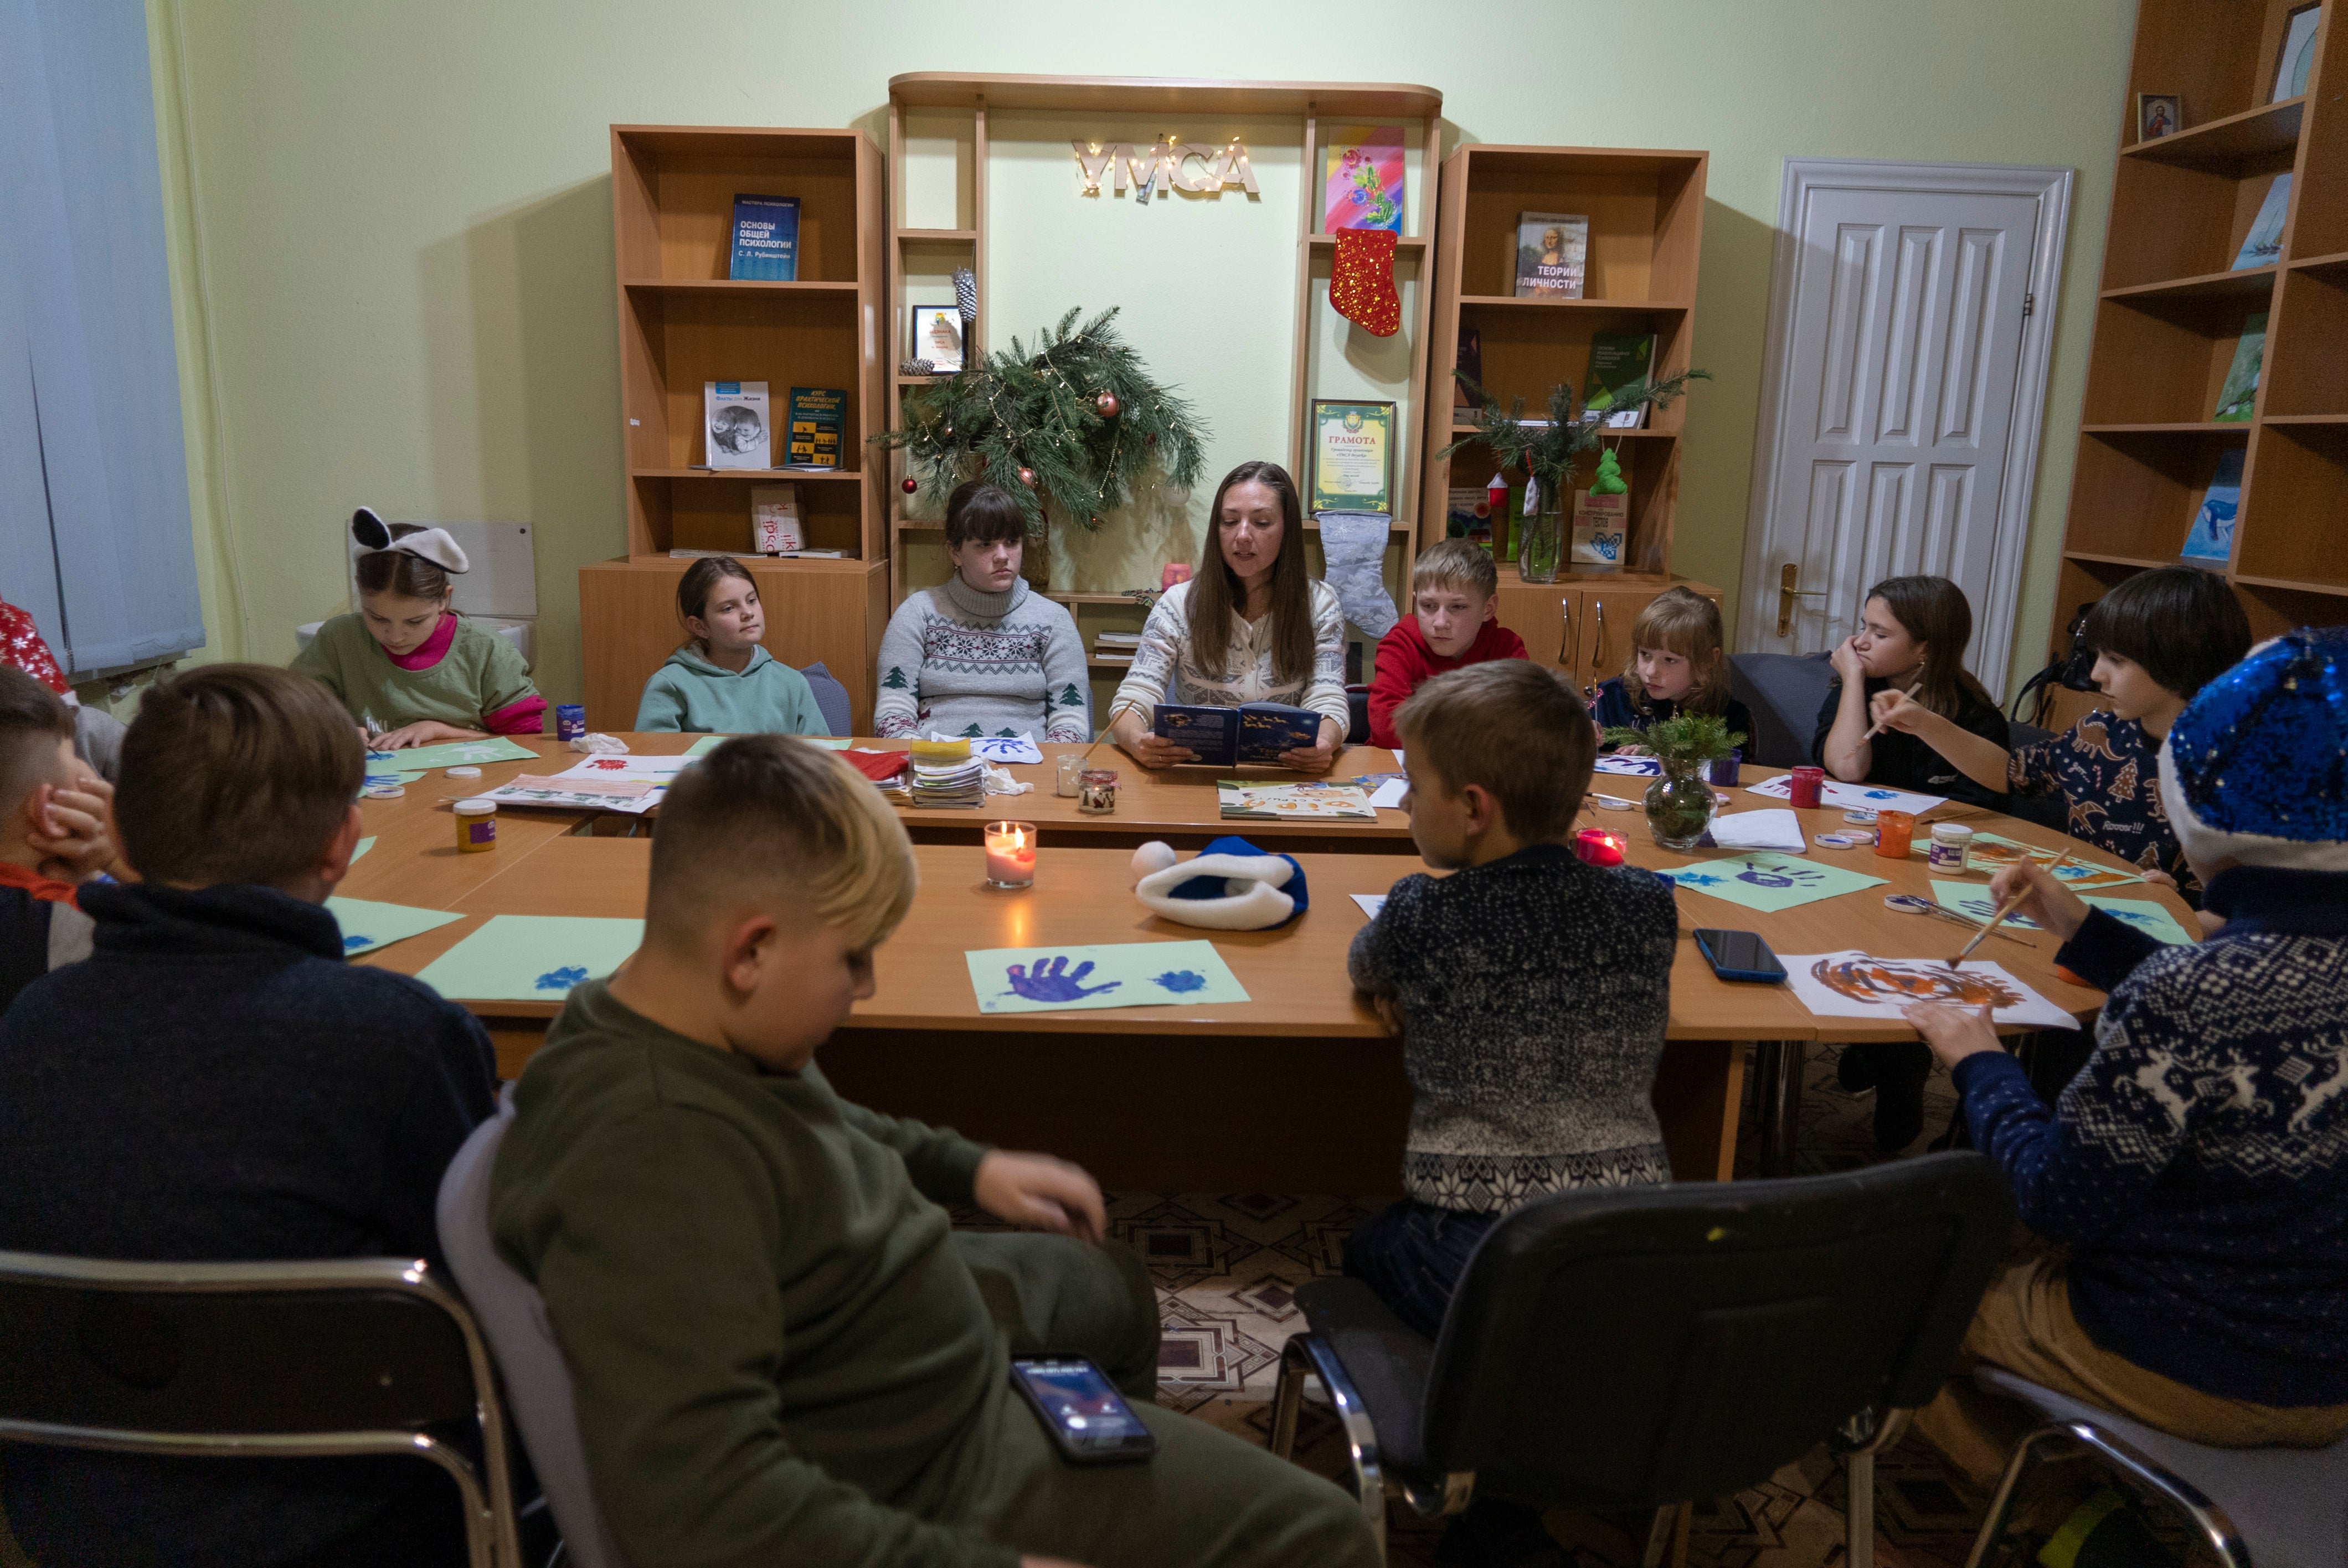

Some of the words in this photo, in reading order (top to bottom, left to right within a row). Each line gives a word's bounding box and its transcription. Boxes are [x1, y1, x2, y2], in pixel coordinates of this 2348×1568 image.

[1072, 140, 1260, 193] YMCA
[740, 221, 775, 230] ОСНОВЫ
[740, 230, 770, 239] ОБЩЕЙ
[739, 239, 791, 249] ПСИХОЛОГИИ
[1538, 266, 1577, 277] ТЕОРИИ
[1523, 277, 1576, 289] ЛИЧНОСТИ
[1329, 436, 1376, 445] ГРАМОТА
